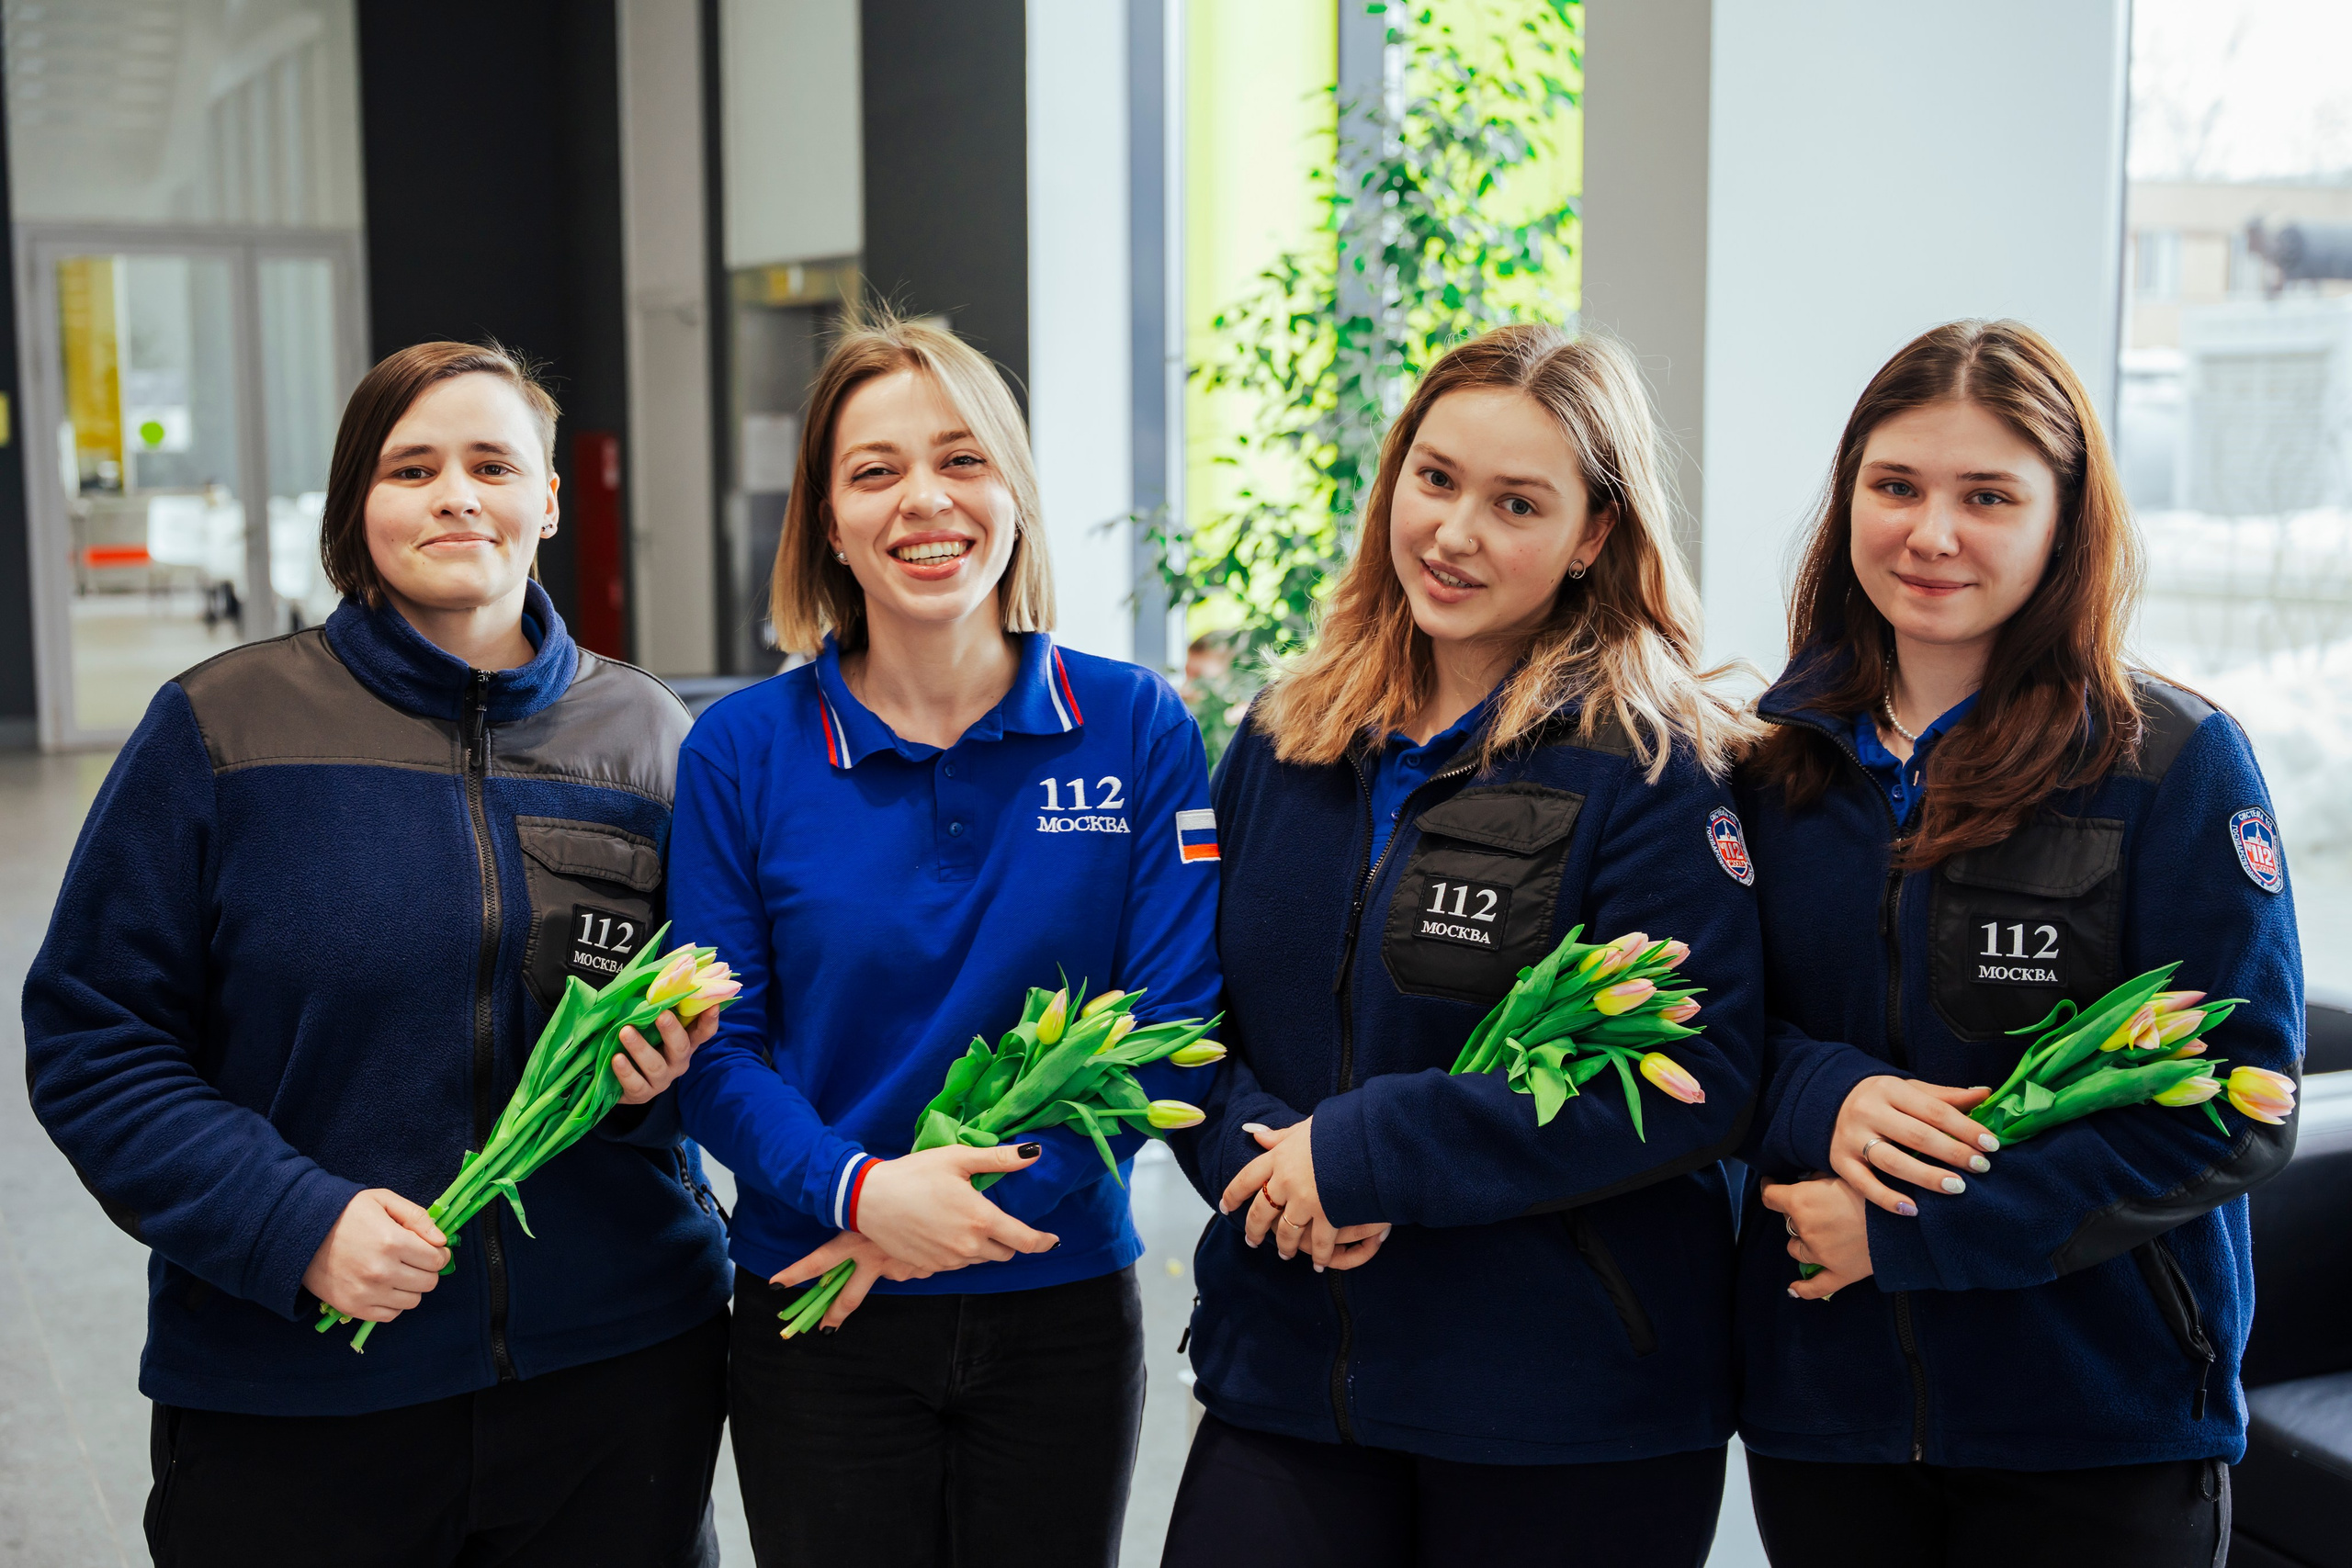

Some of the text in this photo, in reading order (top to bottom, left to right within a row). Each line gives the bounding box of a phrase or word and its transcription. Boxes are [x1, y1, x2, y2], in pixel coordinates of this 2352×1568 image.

[1039, 776, 1125, 811] 112
[1035, 816, 1131, 833] МОСКВА
[2237, 809, 2264, 821] СИСТЕМА
[1719, 841, 1745, 860] 112
[2246, 843, 2274, 867] 112
[1426, 882, 1498, 922] 112
[578, 913, 634, 954] 112
[1420, 920, 1491, 944] МОСКВА
[1980, 921, 2059, 959] 112
[1978, 964, 2058, 982] МОСКВА
